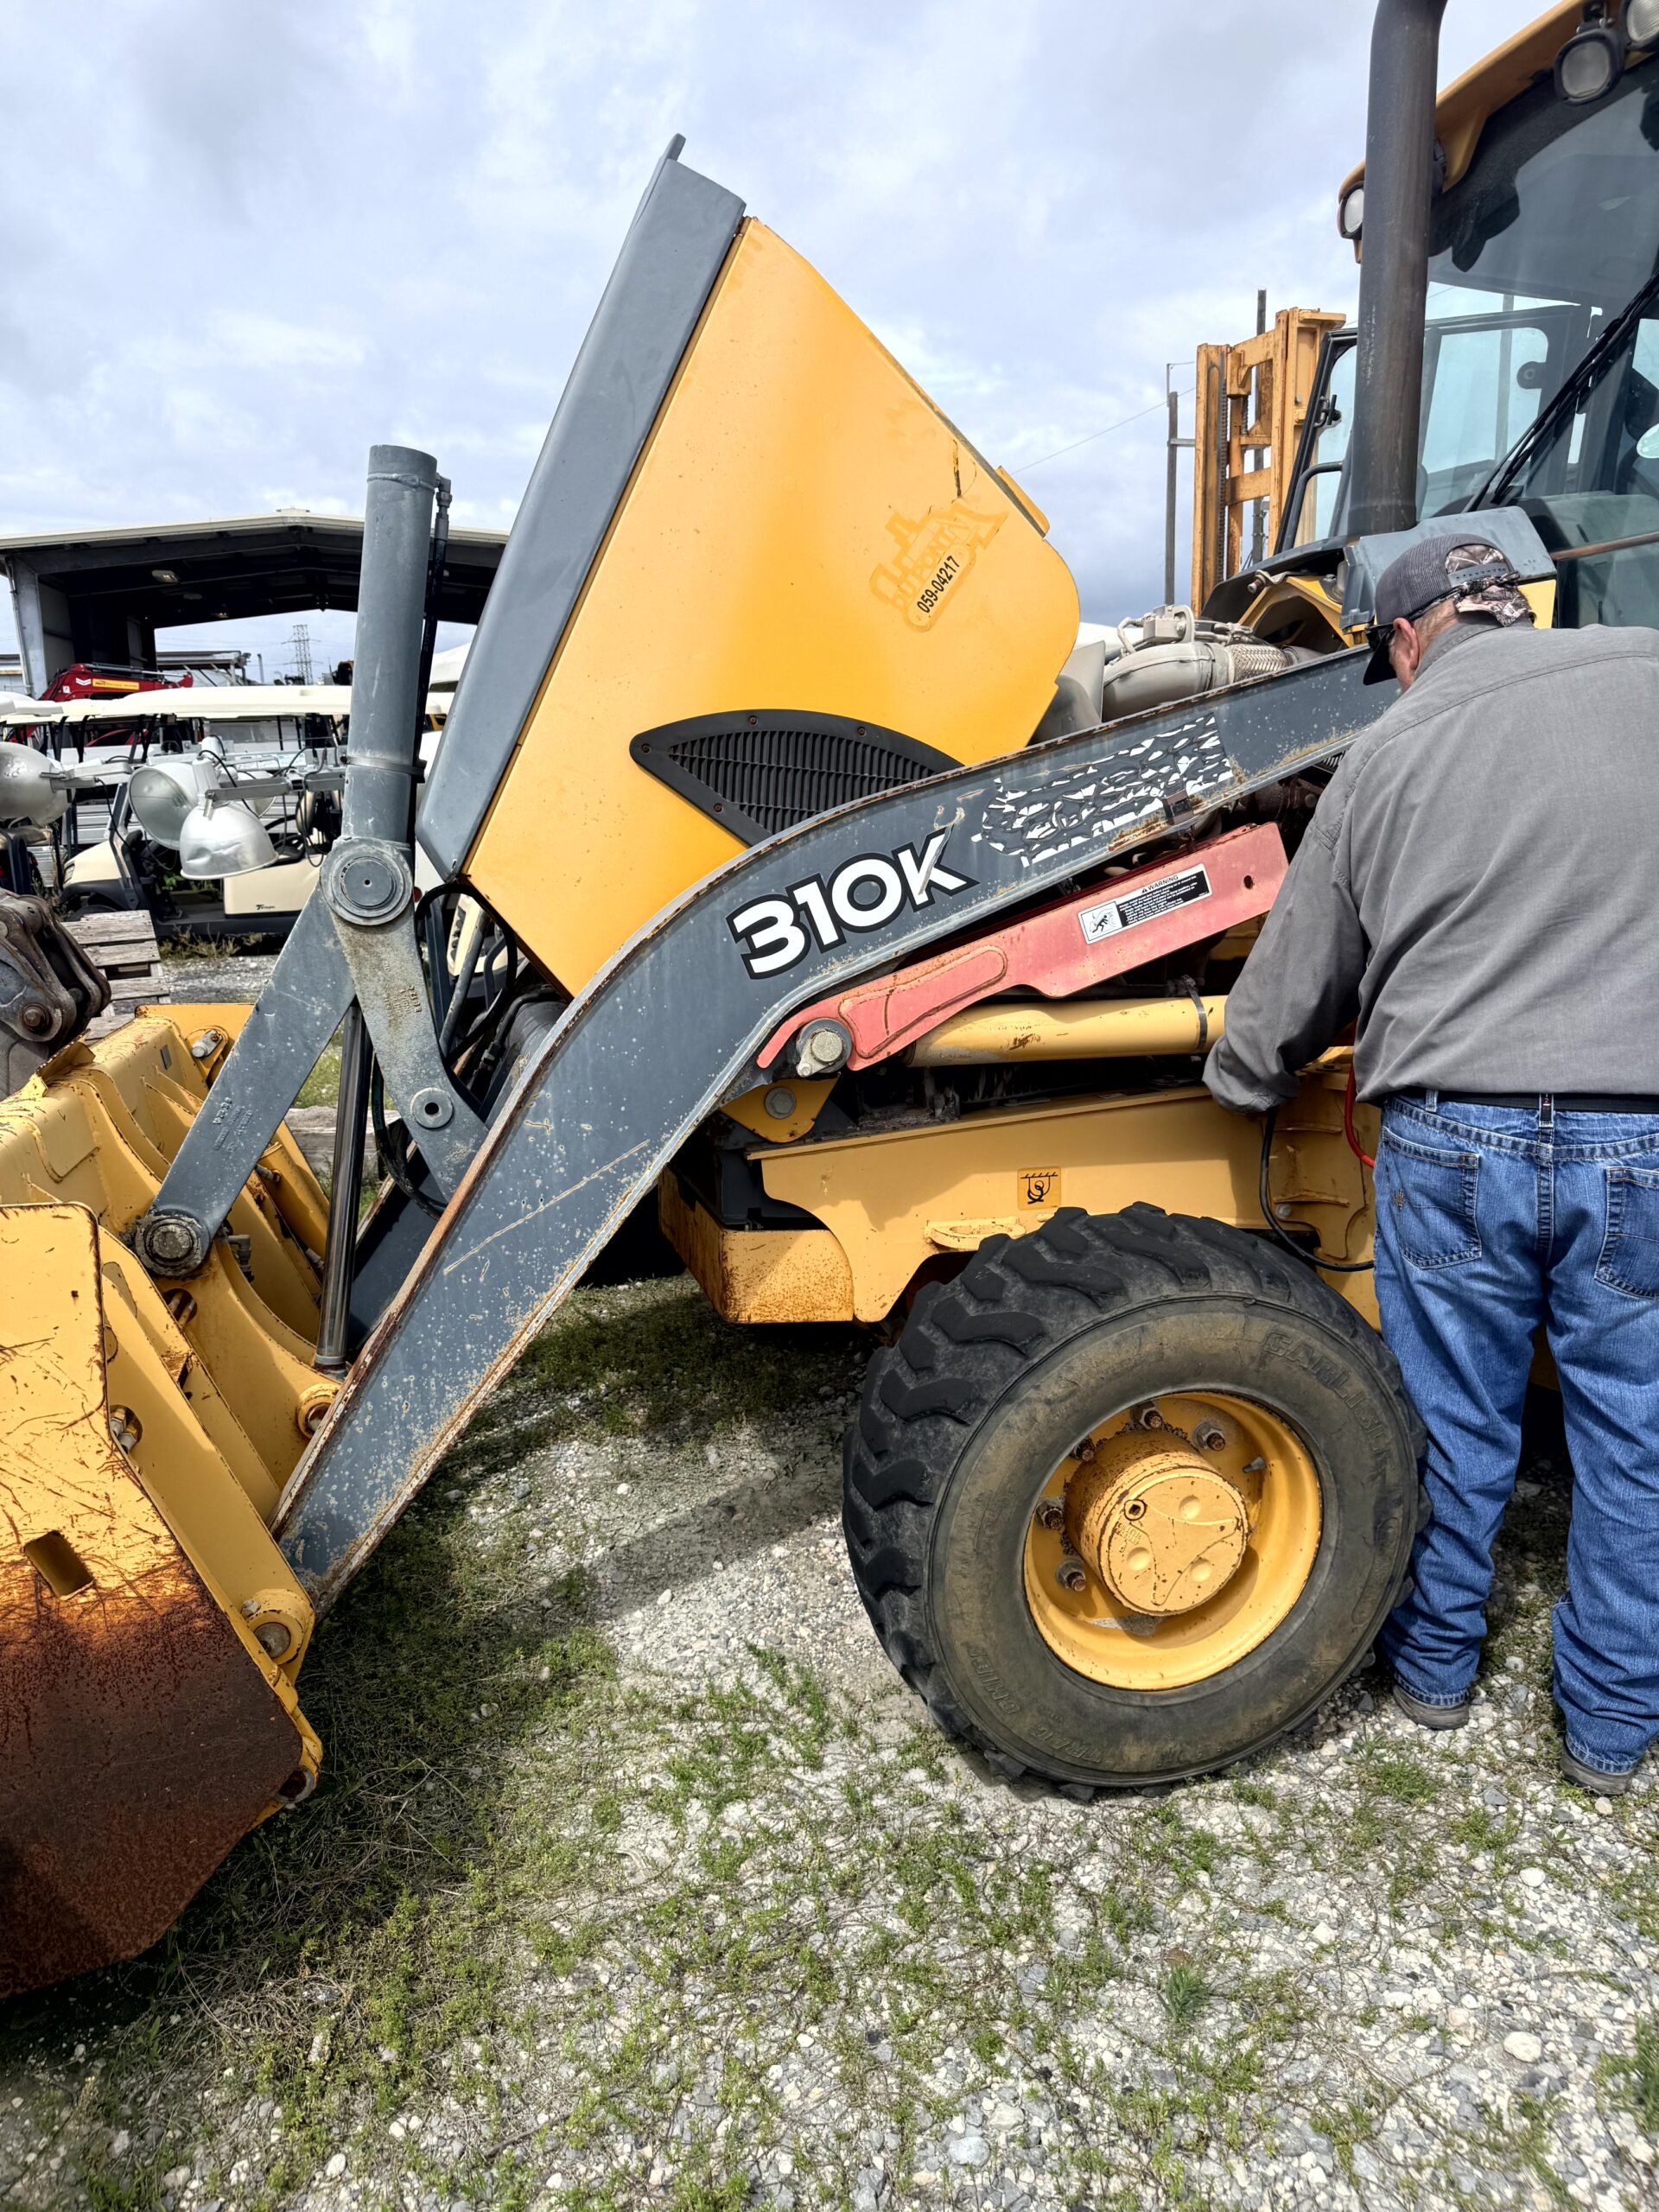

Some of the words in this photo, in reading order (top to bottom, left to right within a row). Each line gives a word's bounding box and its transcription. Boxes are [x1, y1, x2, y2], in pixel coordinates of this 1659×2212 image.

[916, 555, 960, 613] 059-04217
[726, 825, 980, 979] 310K
[1147, 874, 1179, 891] WARNING
